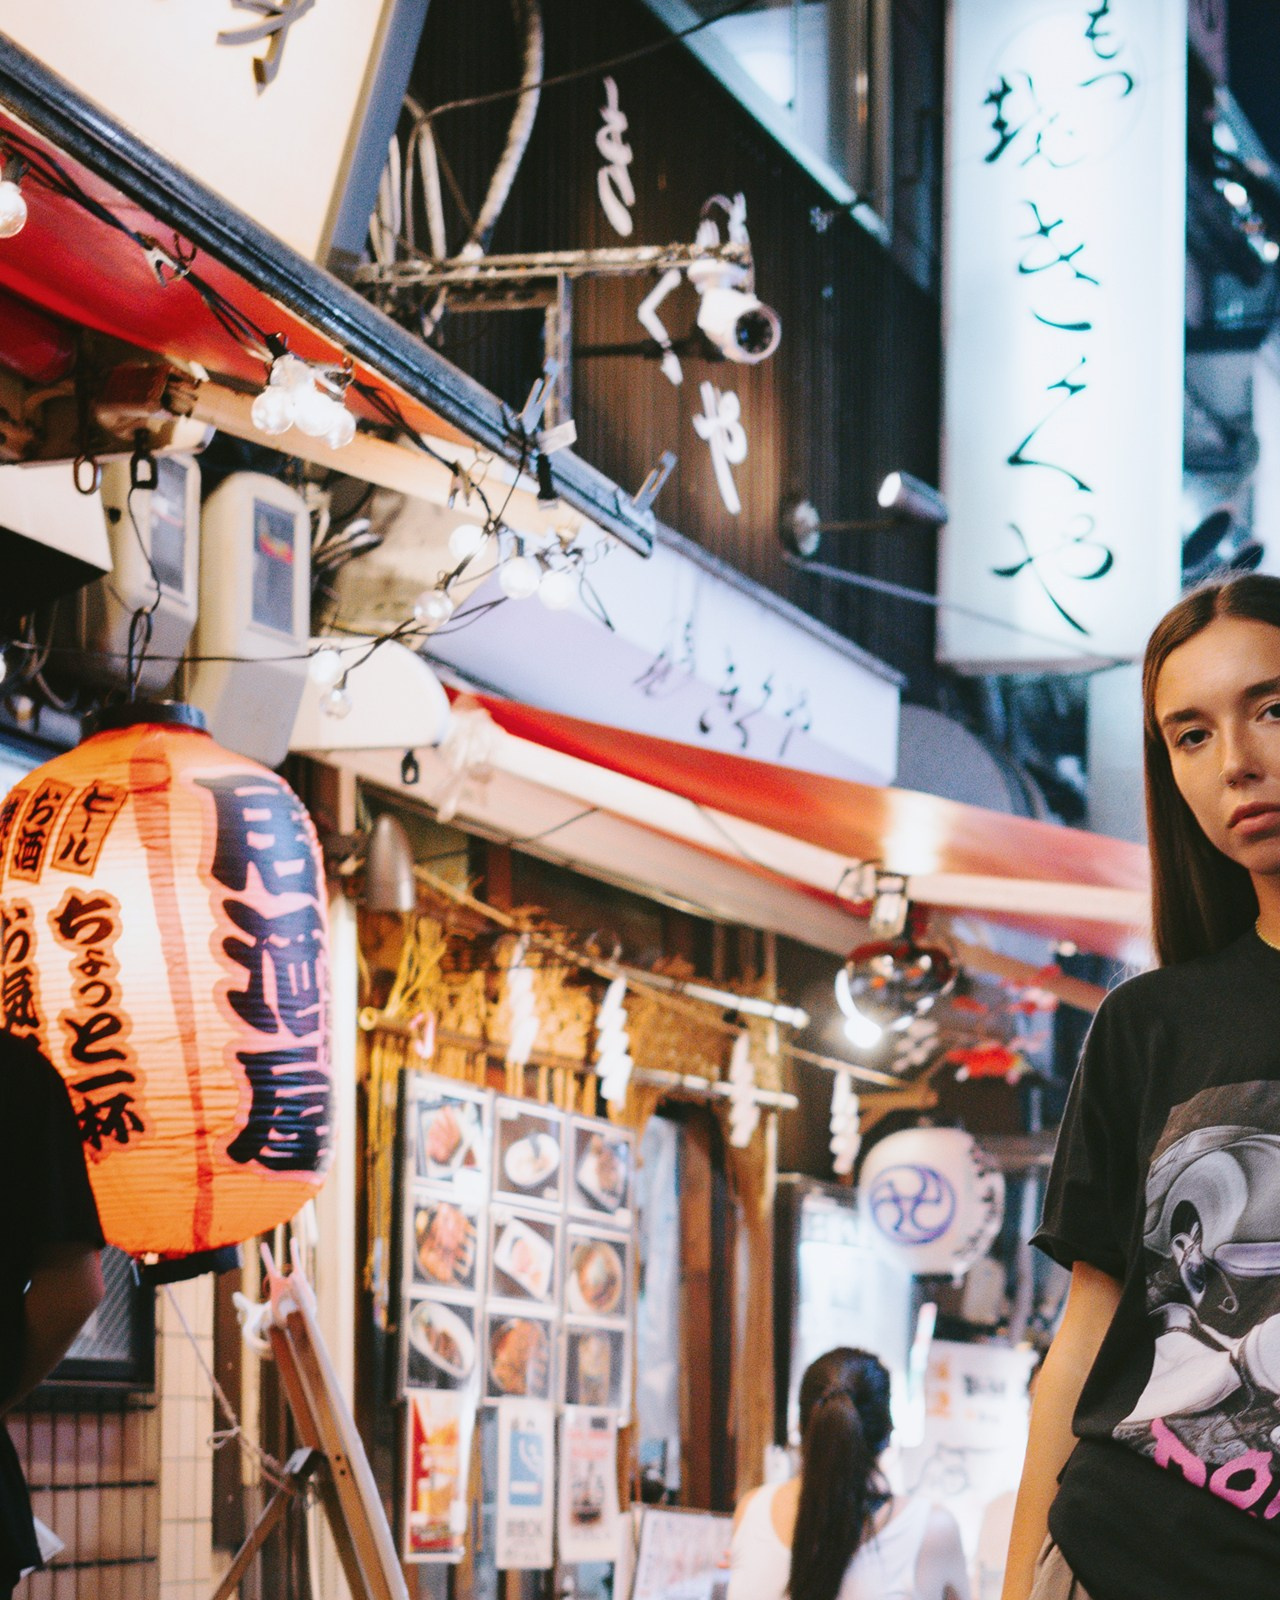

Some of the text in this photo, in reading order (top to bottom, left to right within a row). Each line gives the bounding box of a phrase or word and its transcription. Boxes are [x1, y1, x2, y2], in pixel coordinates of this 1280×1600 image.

[14, 785, 62, 873] お酒
[58, 782, 117, 868] ビール
[54, 895, 146, 1152] ちょっと一杯
